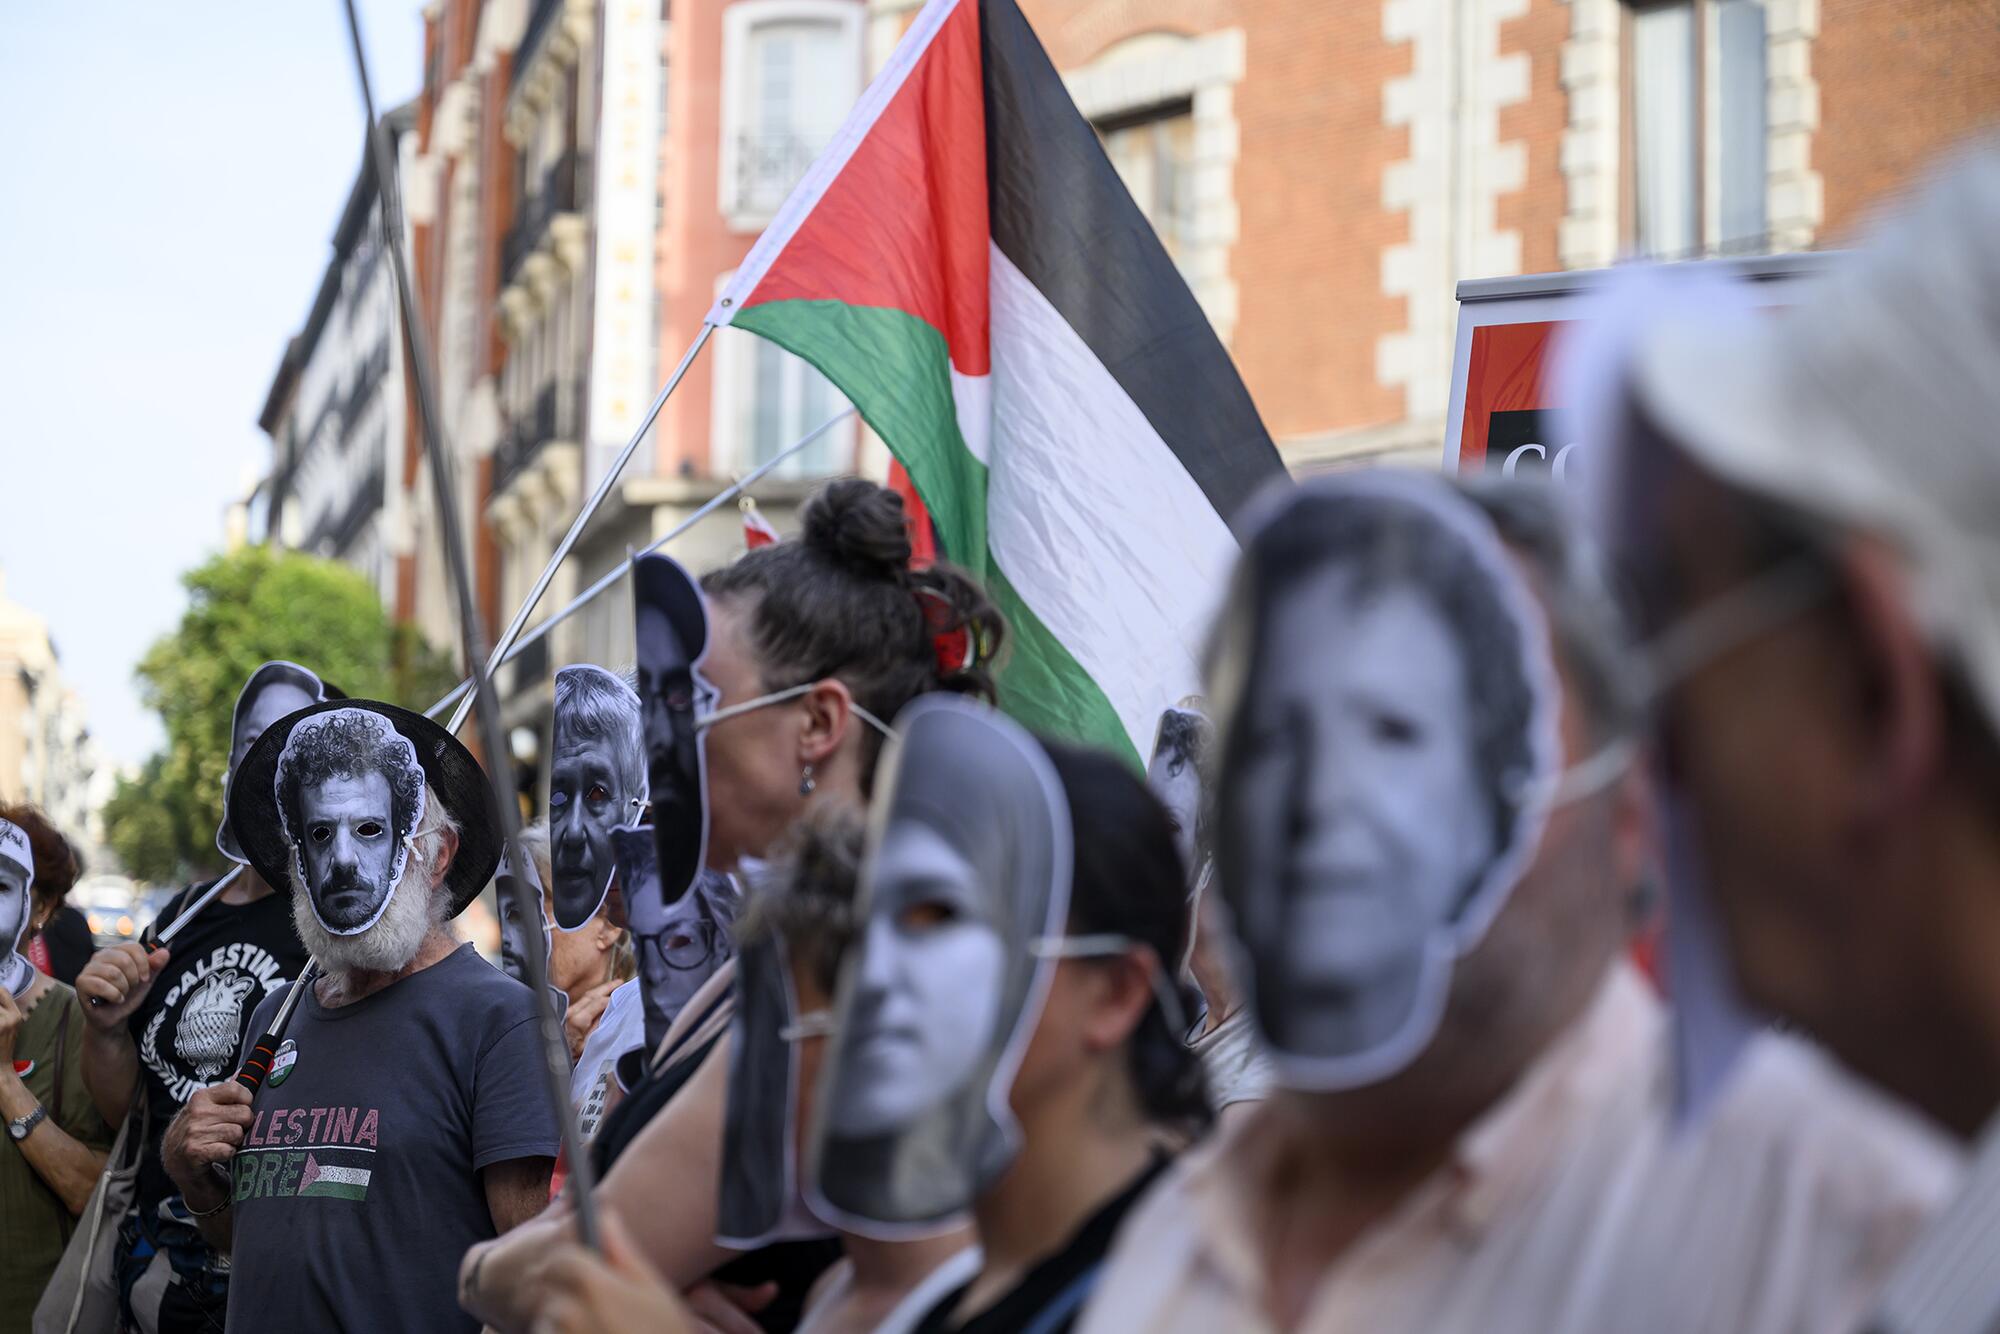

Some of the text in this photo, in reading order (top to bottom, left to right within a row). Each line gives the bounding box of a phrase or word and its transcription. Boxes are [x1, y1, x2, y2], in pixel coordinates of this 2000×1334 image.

[165, 943, 286, 1007] PALESTINA
[243, 1107, 380, 1147] LESTINA
[234, 1151, 306, 1202] BRE
